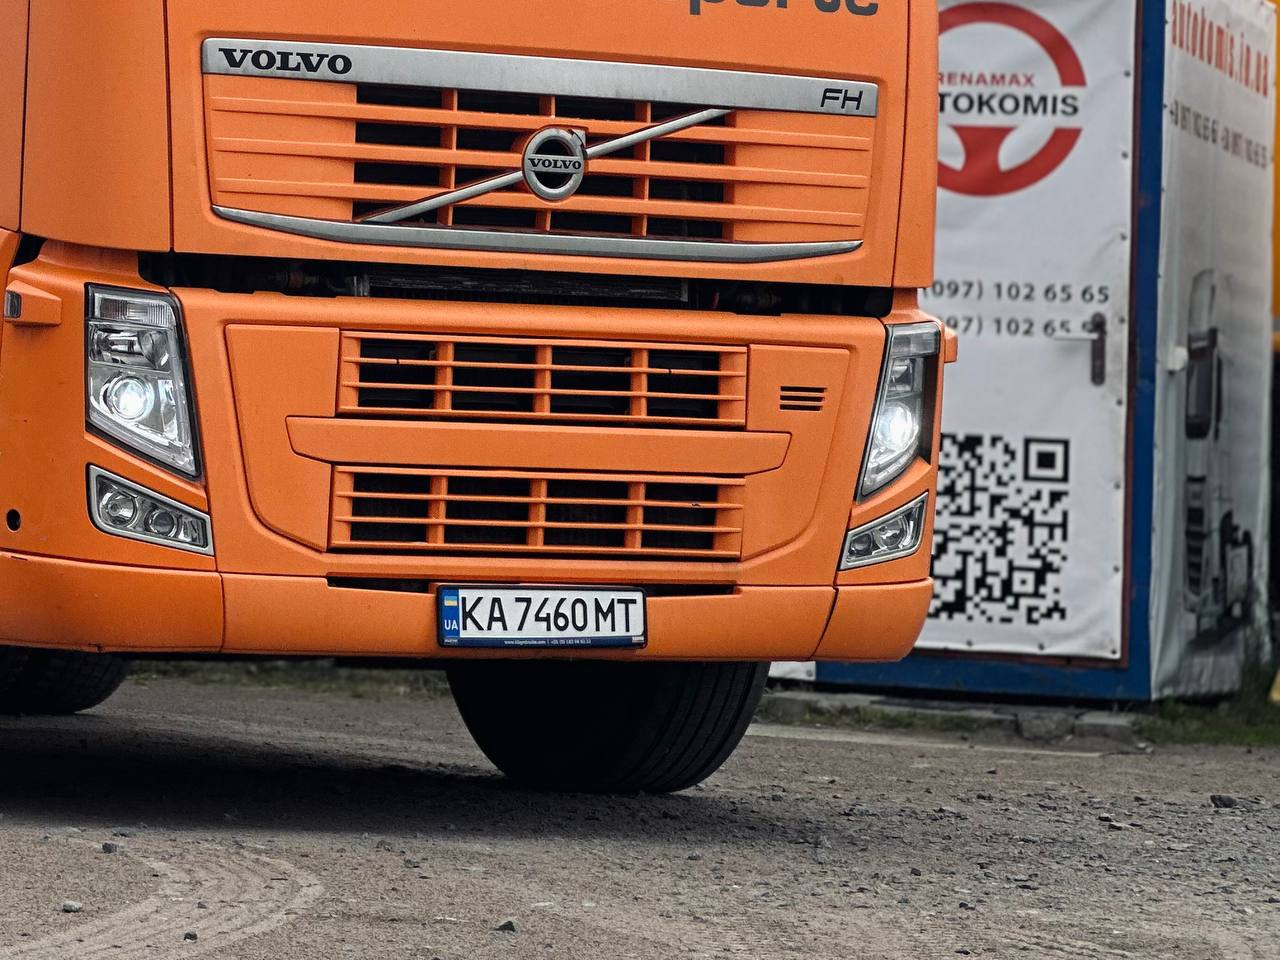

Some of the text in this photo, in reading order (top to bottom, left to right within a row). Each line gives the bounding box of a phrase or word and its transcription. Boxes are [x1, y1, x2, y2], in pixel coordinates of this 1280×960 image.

[218, 47, 863, 110] VOLVO FH
[528, 158, 581, 169] VOLVO
[994, 282, 1034, 301] 102
[1044, 283, 1072, 302] 65
[1081, 285, 1109, 303] 65
[994, 317, 1034, 336] 102
[444, 619, 458, 630] UA
